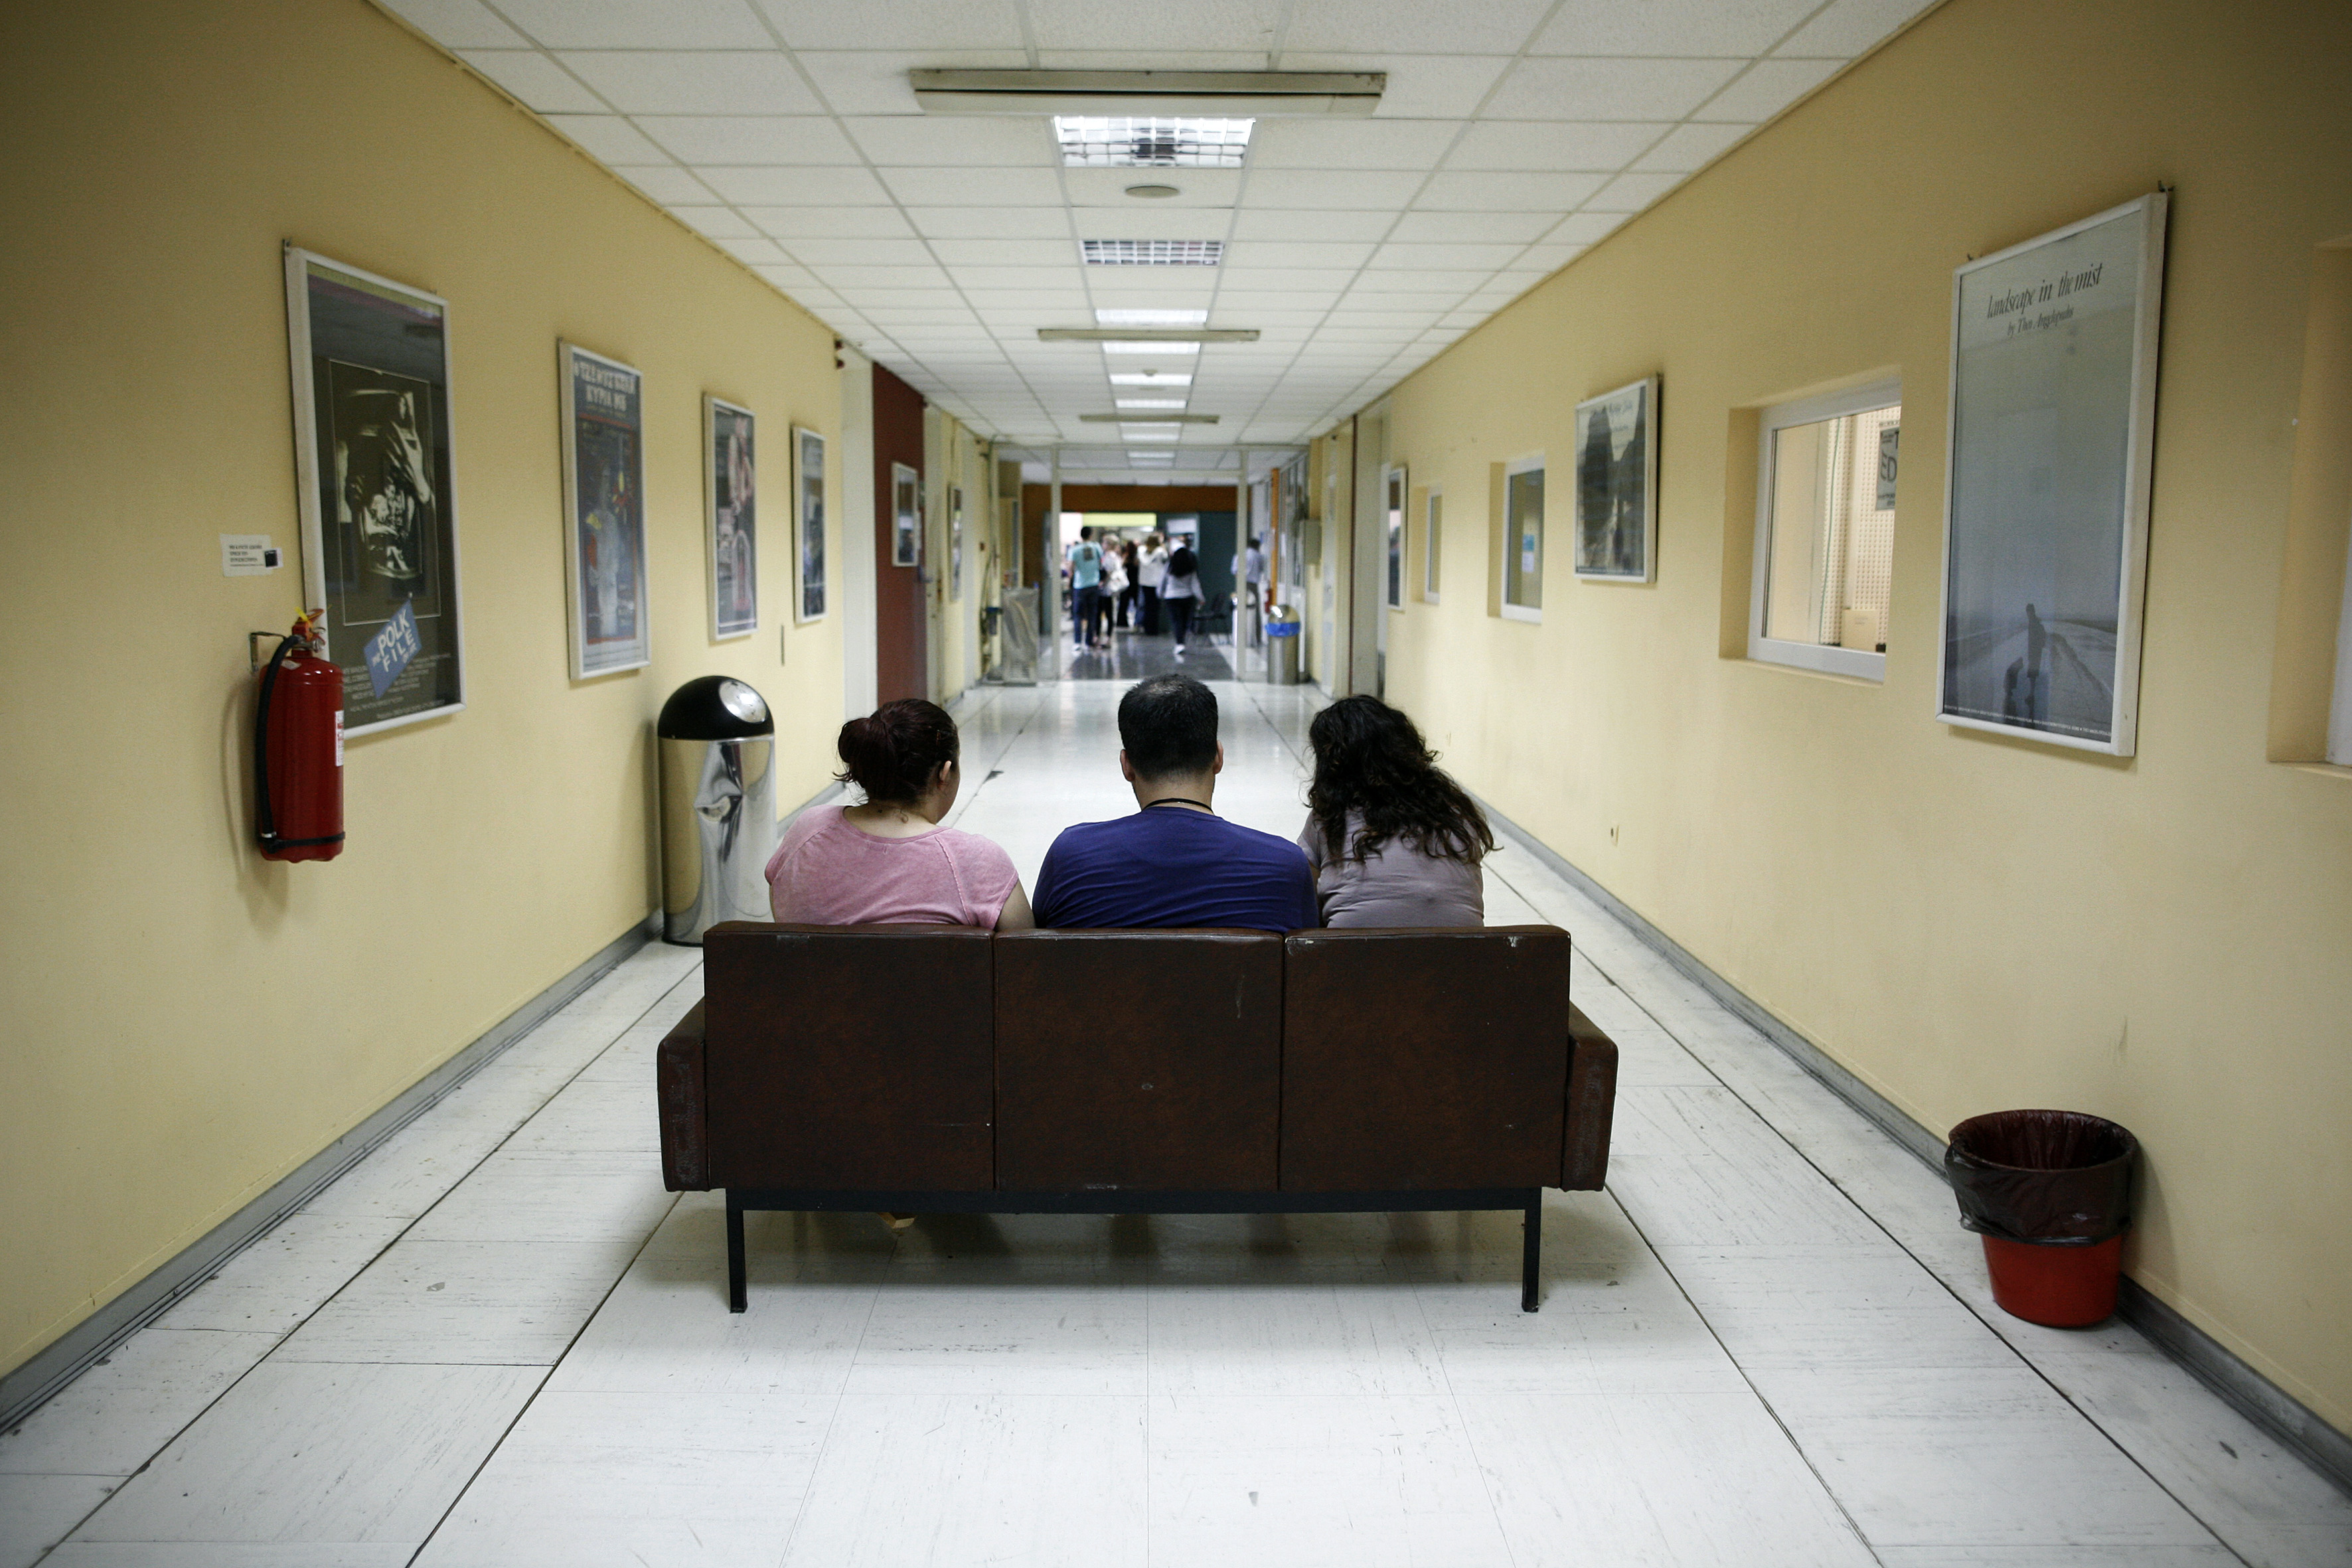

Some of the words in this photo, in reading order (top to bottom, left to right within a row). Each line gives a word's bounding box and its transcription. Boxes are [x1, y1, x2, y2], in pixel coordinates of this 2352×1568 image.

[1987, 288, 2035, 319] landscape
[2039, 279, 2053, 303] in
[2058, 271, 2073, 297] the
[2075, 263, 2102, 291] mist
[378, 609, 410, 657] POLK
[383, 629, 414, 672] FILE
